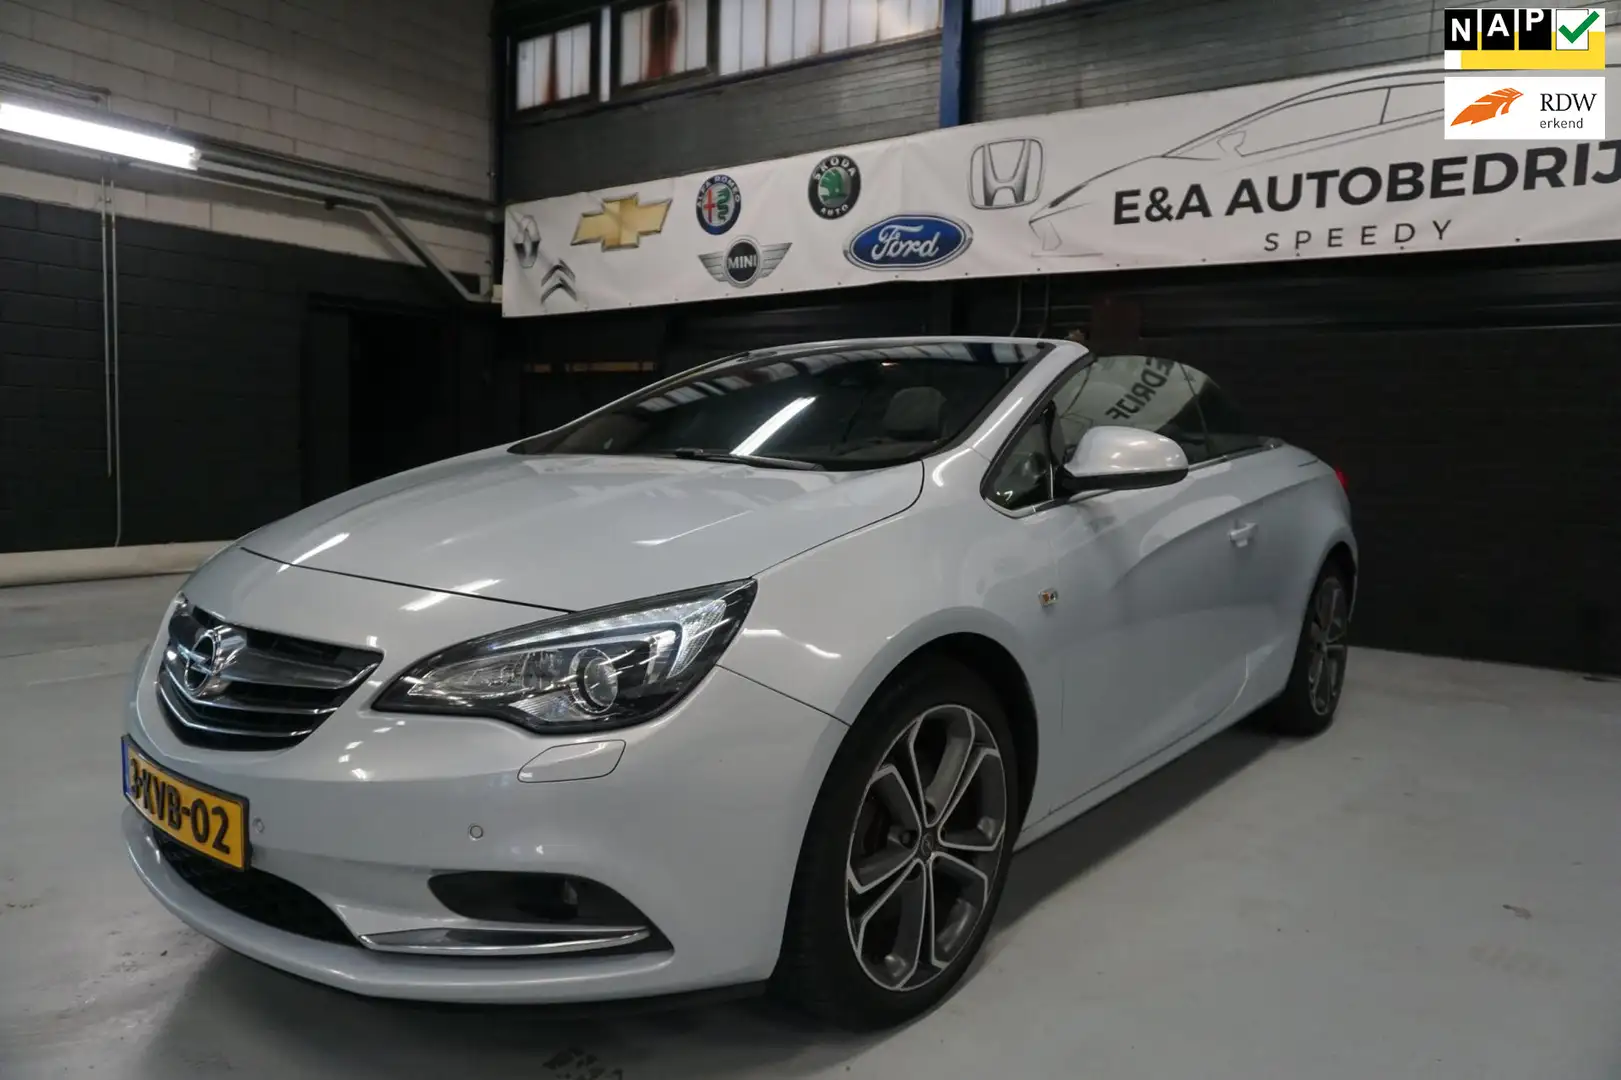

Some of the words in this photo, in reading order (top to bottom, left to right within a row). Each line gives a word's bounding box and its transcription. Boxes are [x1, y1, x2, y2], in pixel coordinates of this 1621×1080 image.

[714, 175, 741, 203] ROMEO
[1114, 183, 1213, 226] E&A
[821, 204, 849, 217] AUTO
[871, 224, 941, 261] Ford
[1263, 218, 1452, 252] SPEEDY
[728, 255, 757, 269] MINI
